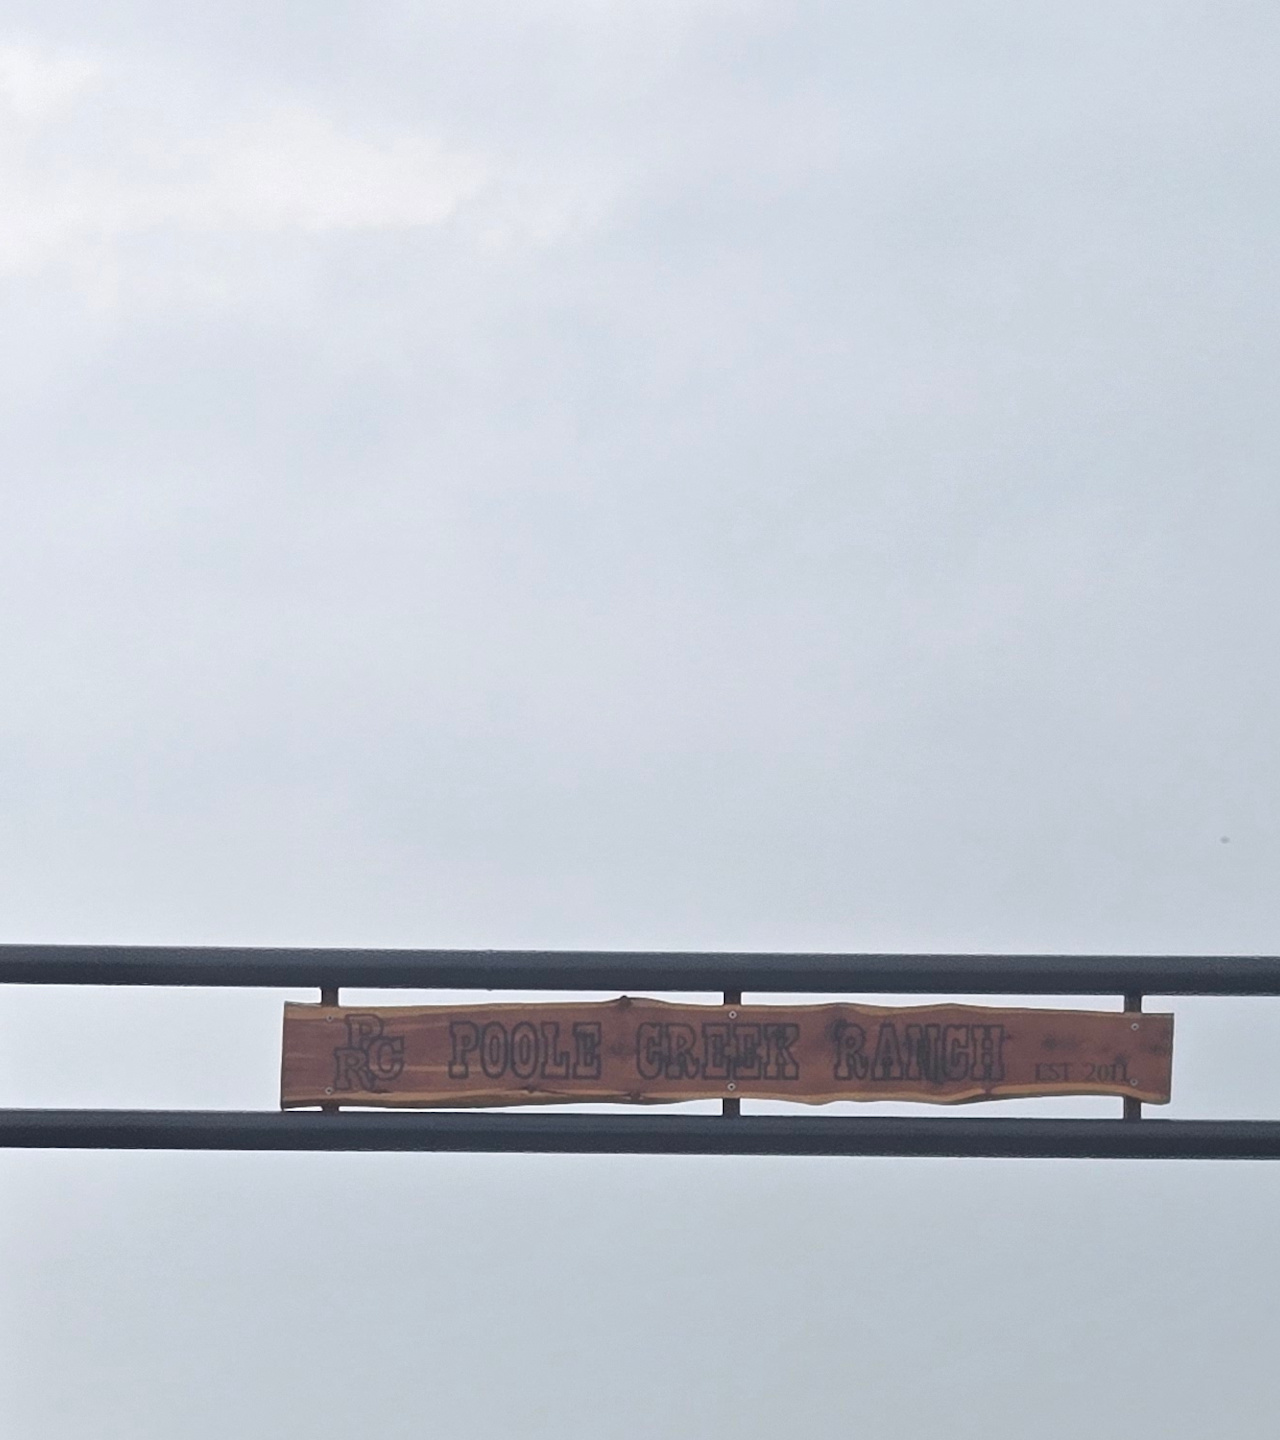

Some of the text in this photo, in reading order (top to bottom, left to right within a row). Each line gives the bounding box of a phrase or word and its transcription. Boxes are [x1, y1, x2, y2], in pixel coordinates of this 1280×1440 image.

[448, 1020, 1006, 1082] POOLE CREEK RANCH
[1035, 1062, 1073, 1081] EST
